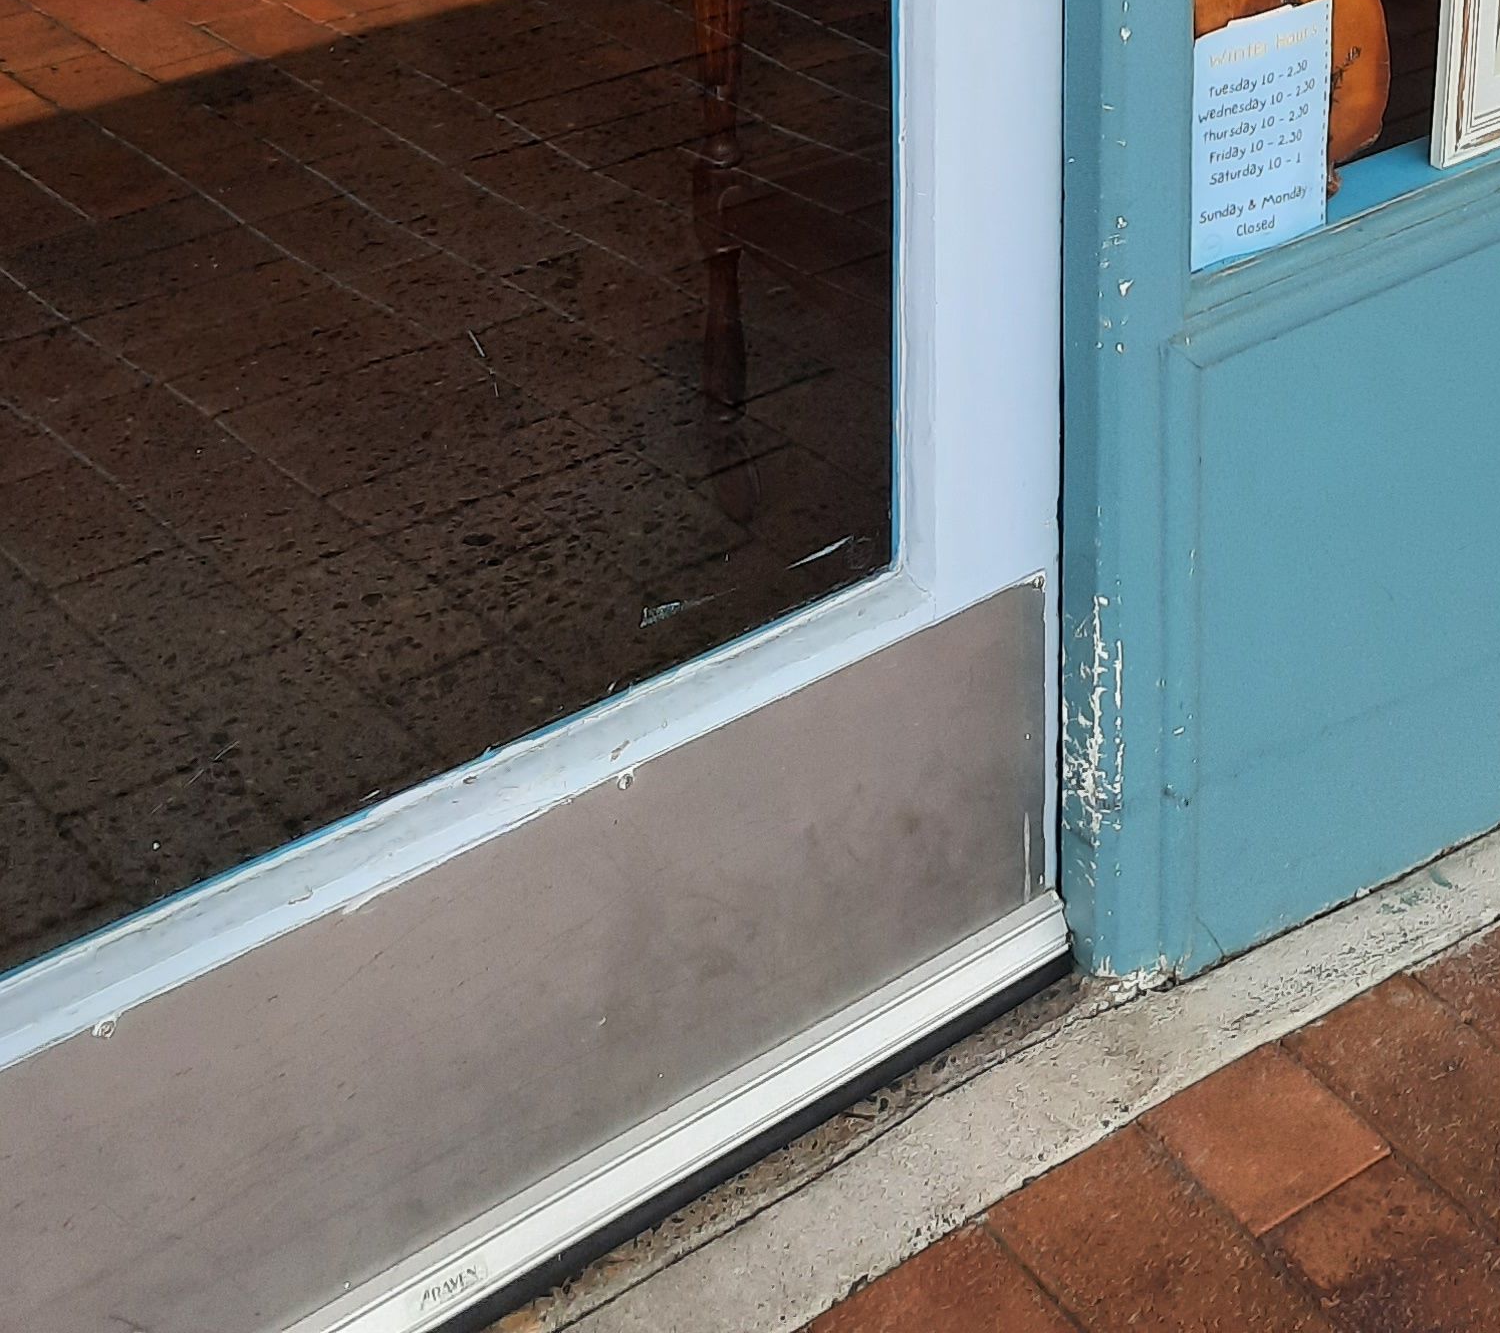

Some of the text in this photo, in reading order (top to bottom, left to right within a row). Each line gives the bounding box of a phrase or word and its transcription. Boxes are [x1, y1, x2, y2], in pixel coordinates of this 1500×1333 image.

[1261, 72, 1275, 88] 10
[1286, 59, 1309, 79] 2.30
[1270, 91, 1284, 107] 10
[1295, 77, 1316, 97] 2.30
[1261, 114, 1275, 130] 10
[1287, 102, 1310, 122] 2.30
[1209, 146, 1247, 165] Friday
[1249, 138, 1264, 154] 10
[1277, 127, 1304, 147] 2.30
[1208, 163, 1265, 186] Saturday
[1267, 156, 1282, 172] 10
[1295, 151, 1301, 164] 1
[1199, 184, 1308, 225] Sunday & Monday
[1236, 214, 1276, 238] Closed
